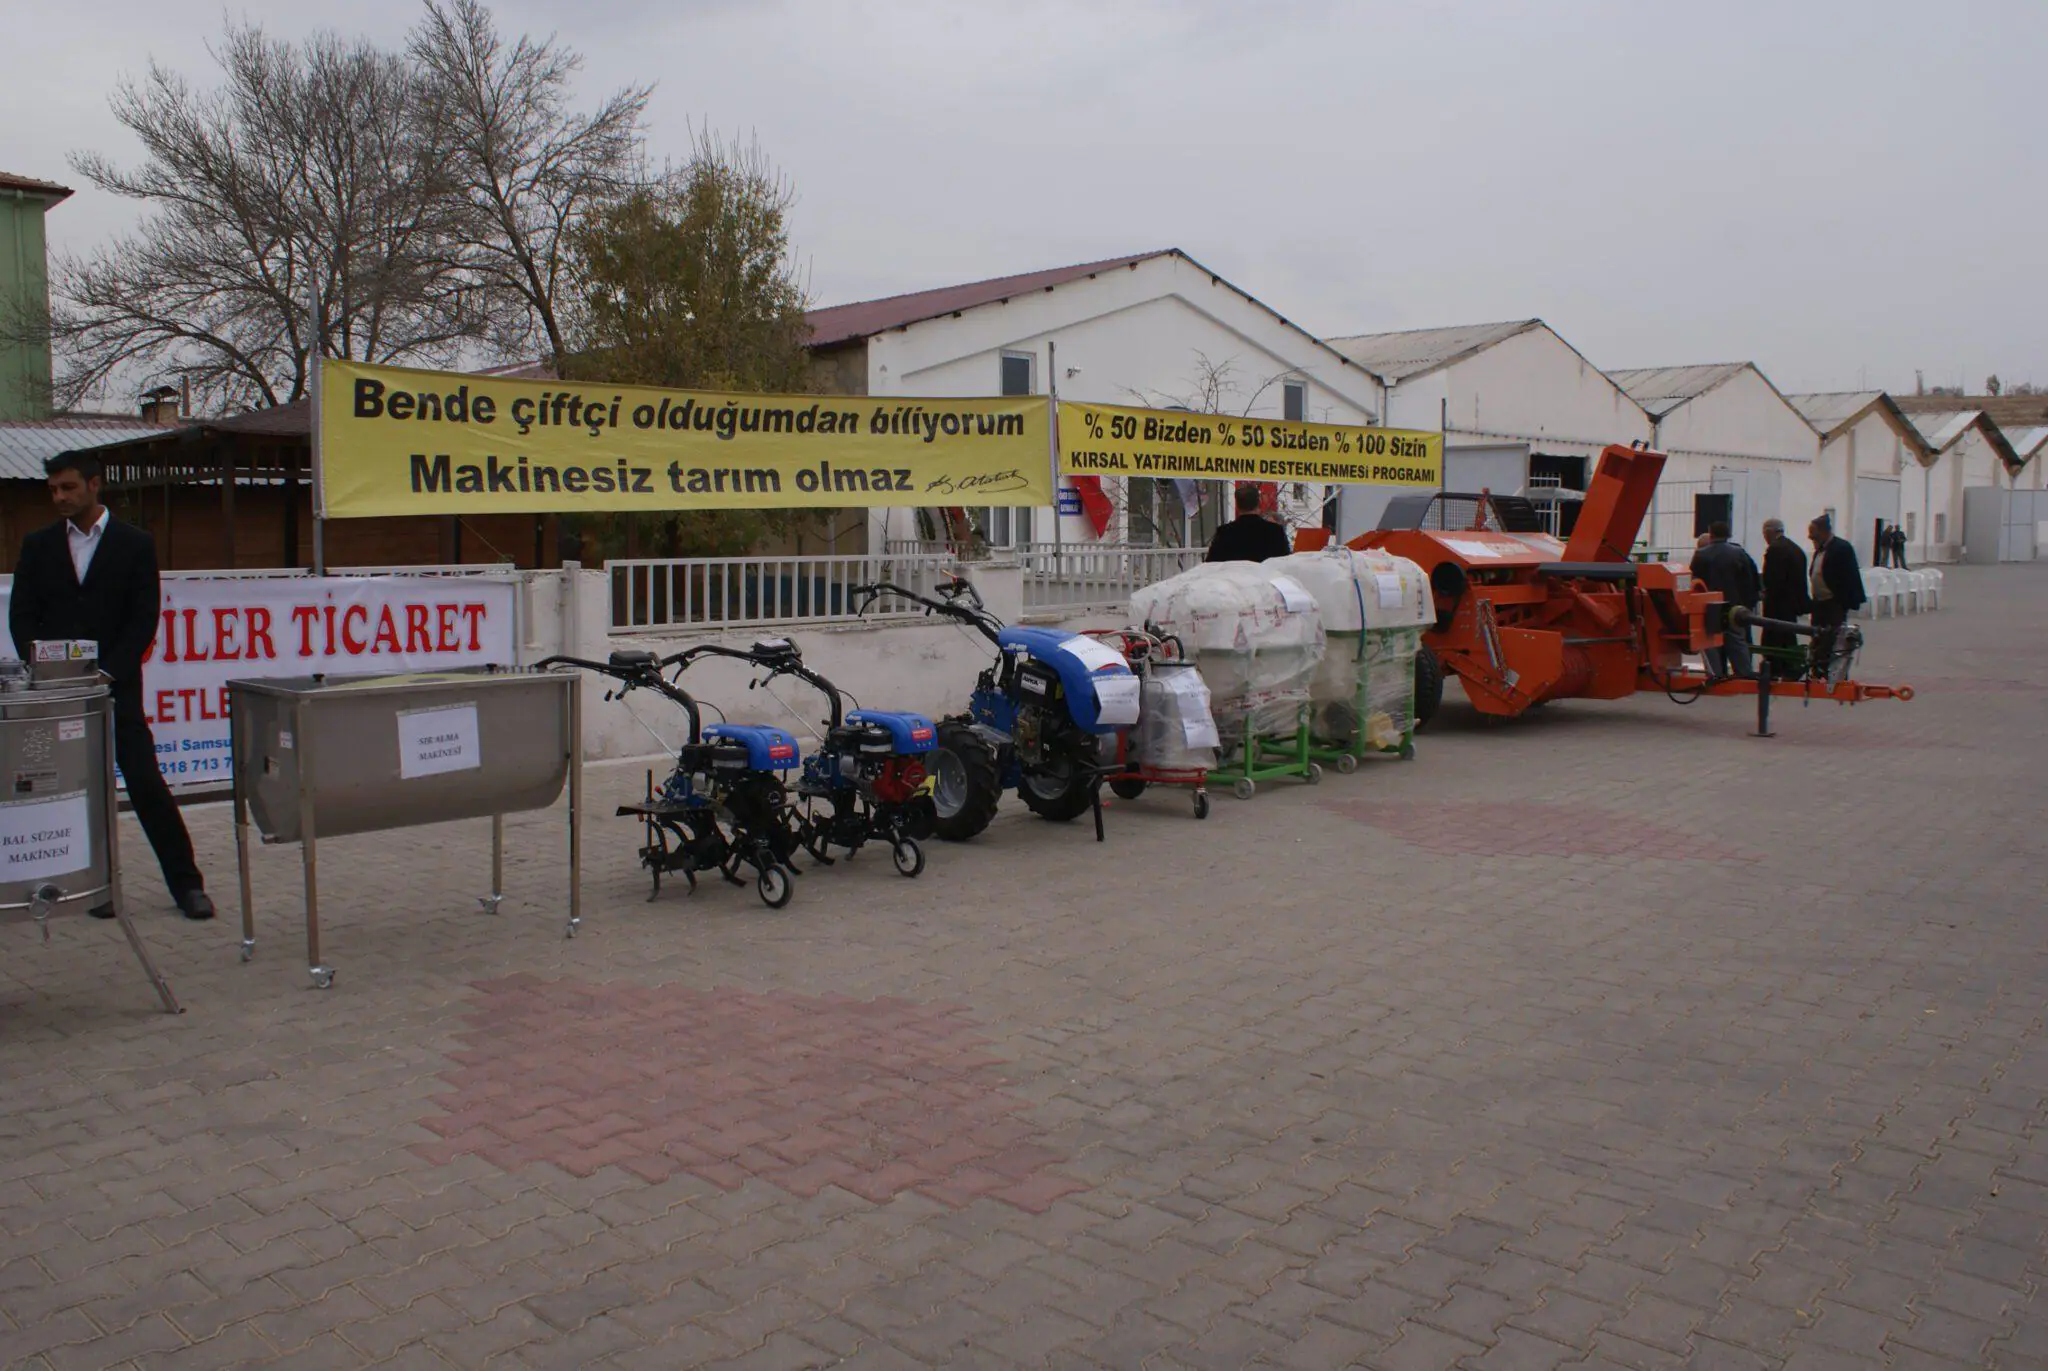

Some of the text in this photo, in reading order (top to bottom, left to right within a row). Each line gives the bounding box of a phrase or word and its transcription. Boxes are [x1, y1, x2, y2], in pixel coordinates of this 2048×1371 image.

[354, 378, 1024, 443] Bende çiftçi olduğumdan biliyorum
[1111, 415, 1137, 440] 50
[1143, 416, 1212, 444] Bizden
[1241, 424, 1264, 447] 50
[1270, 426, 1329, 452] Sizden
[1356, 433, 1386, 456] 100
[1389, 436, 1427, 458] Sizin
[410, 454, 914, 493] Makinesiz tarım olmaz
[1071, 451, 1129, 469] KIRSAL
[1133, 452, 1255, 474] YATIRIMLARININ
[1372, 465, 1435, 483] PROGRAMI
[291, 592, 487, 657] TİCARET
[191, 757, 218, 772] 713
[2, 828, 72, 846] BAL SÜZME
[8, 845, 70, 864] MAKİNESİ
